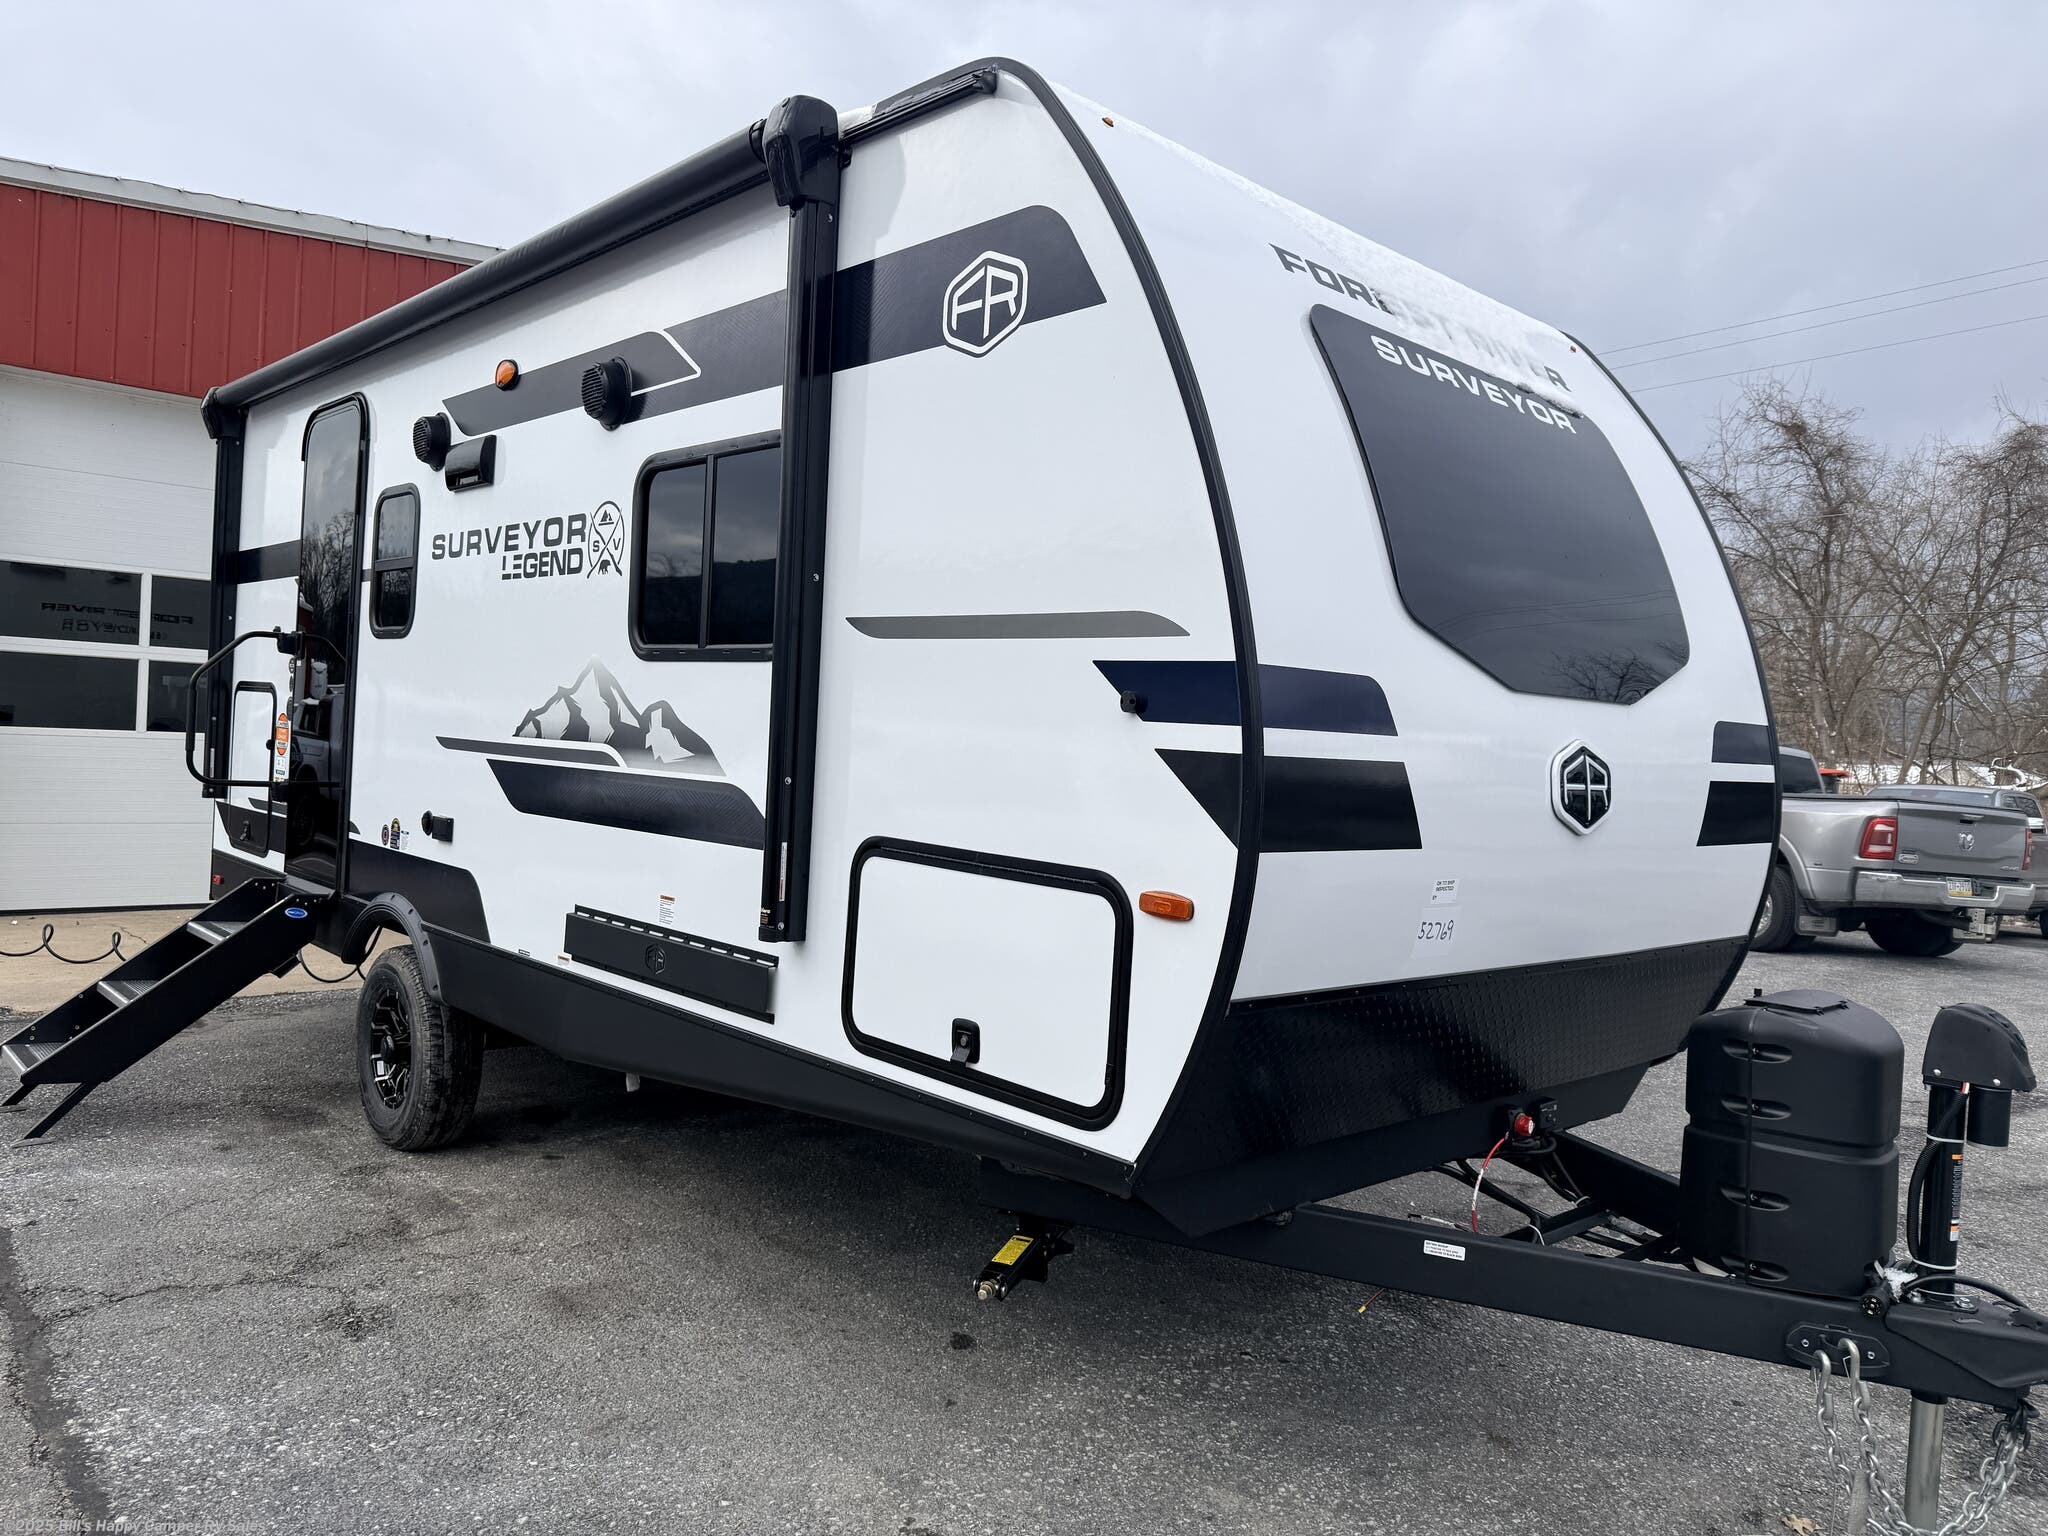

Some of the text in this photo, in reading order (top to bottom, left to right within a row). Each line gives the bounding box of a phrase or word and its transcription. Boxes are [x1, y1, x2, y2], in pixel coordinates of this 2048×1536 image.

[1371, 335, 1576, 434] SURVEYOR
[432, 513, 587, 561] SURVEYOR
[501, 547, 584, 580] LEGEND
[1417, 919, 1454, 940] 52769
